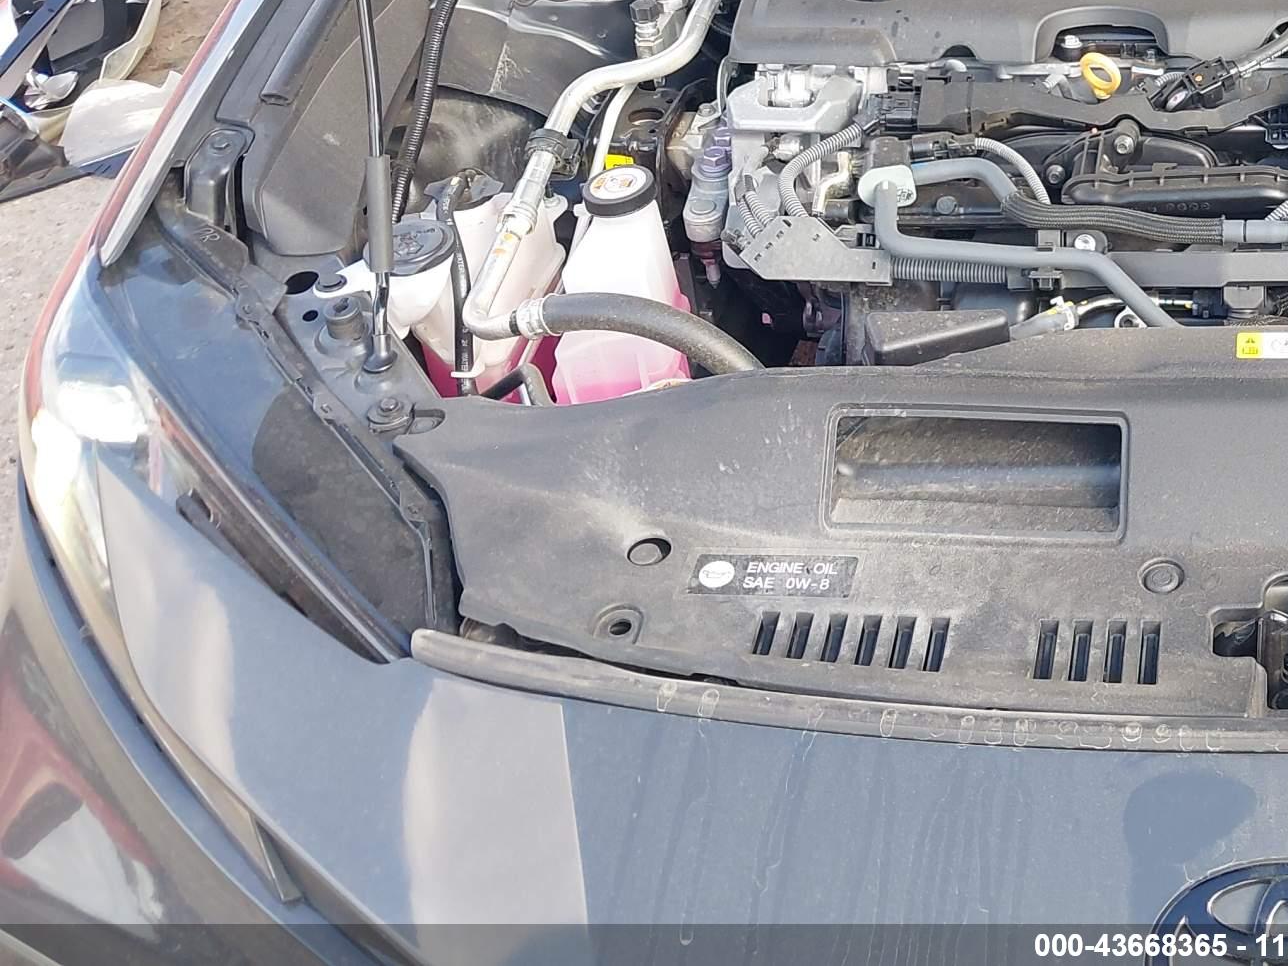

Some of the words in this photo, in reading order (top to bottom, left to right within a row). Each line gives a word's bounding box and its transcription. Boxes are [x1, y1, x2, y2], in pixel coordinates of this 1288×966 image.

[746, 562, 804, 575] ENGINE
[813, 562, 838, 575] OIL
[742, 576, 775, 590] SAE
[785, 577, 830, 591] 0W-8
